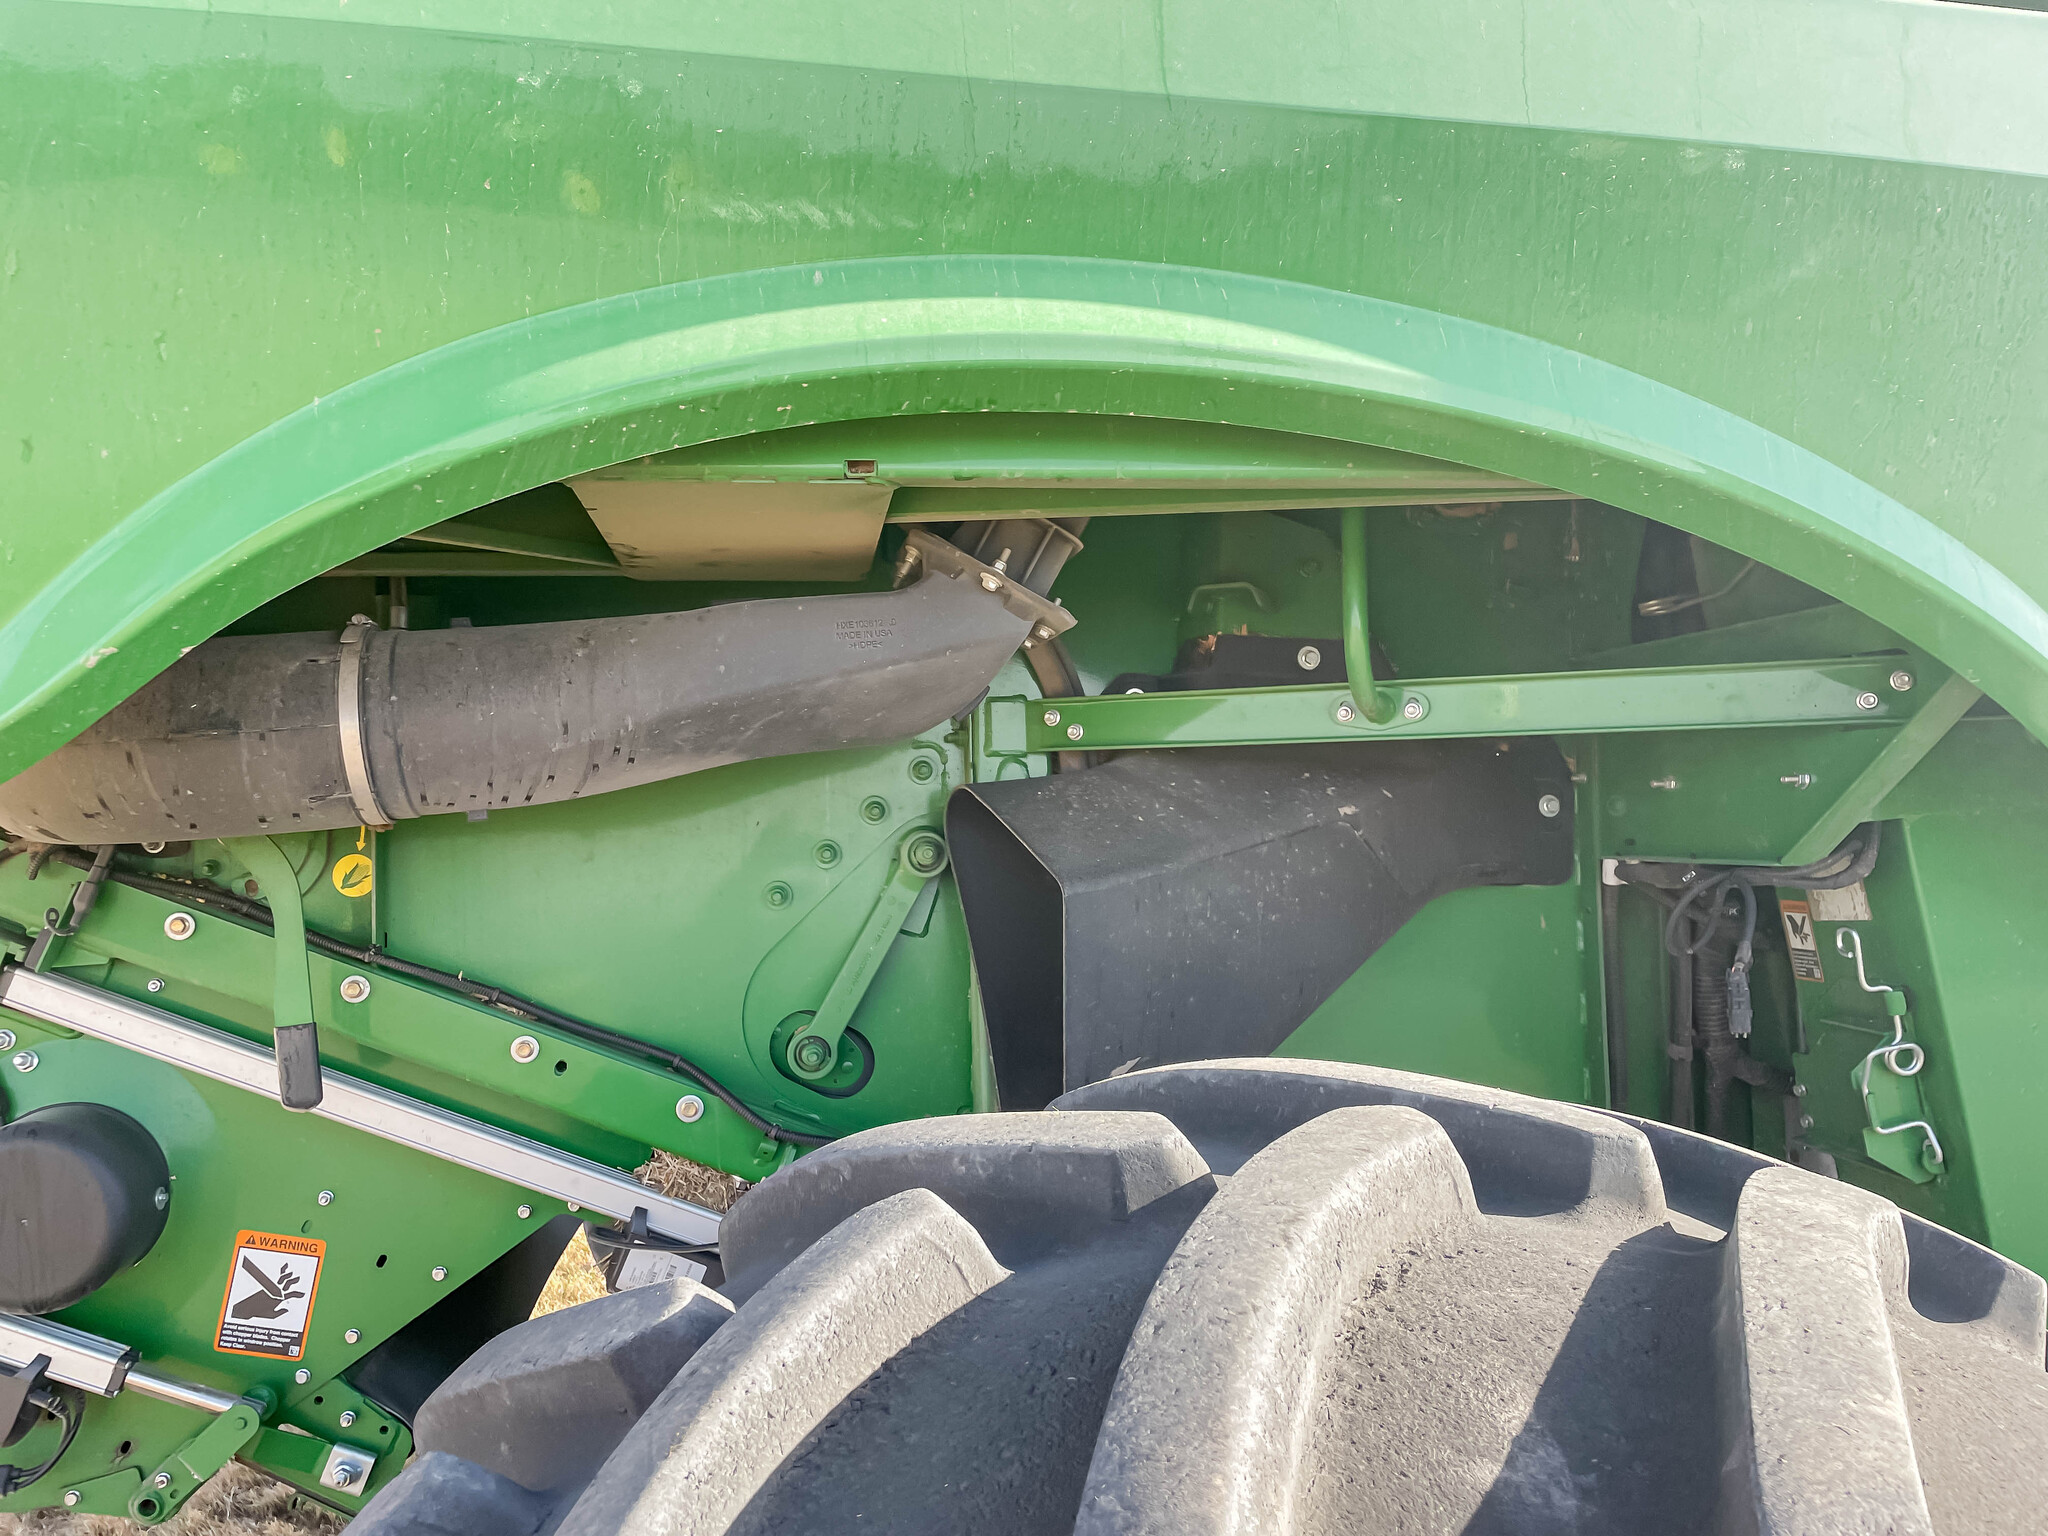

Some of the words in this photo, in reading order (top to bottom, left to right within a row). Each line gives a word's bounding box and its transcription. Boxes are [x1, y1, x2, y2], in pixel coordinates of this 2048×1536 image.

[836, 630, 861, 640] MADE
[863, 630, 873, 639] IN
[874, 629, 893, 638] USA
[259, 1236, 318, 1253] WARNING
[255, 1327, 269, 1335] injury
